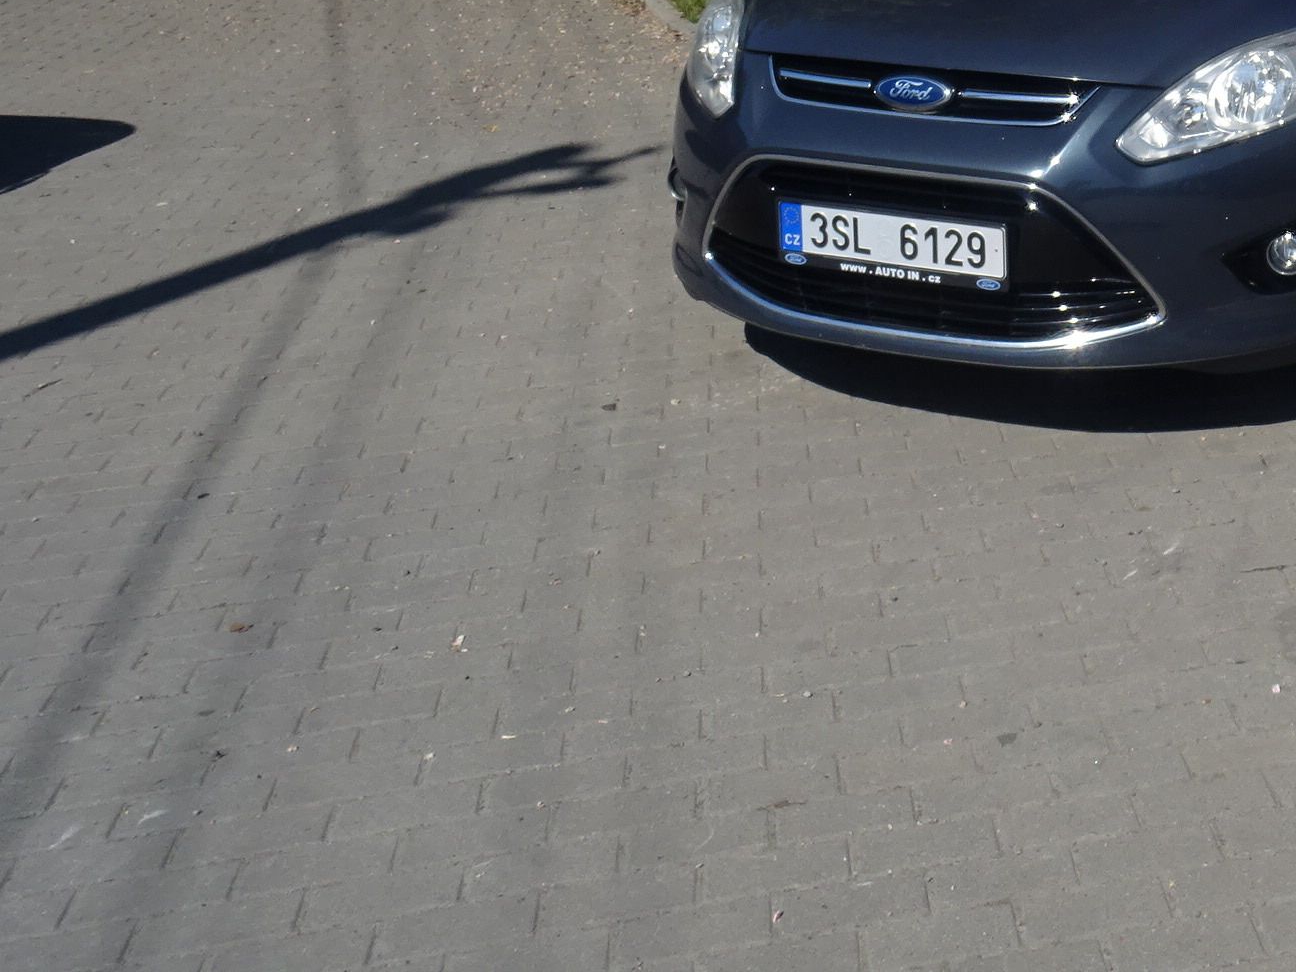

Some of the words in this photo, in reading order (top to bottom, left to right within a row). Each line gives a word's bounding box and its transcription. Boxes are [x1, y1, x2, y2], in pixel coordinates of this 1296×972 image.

[889, 79, 931, 101] Ford
[784, 233, 801, 246] CZ
[809, 212, 871, 255] 3SL
[900, 223, 986, 269] 6129
